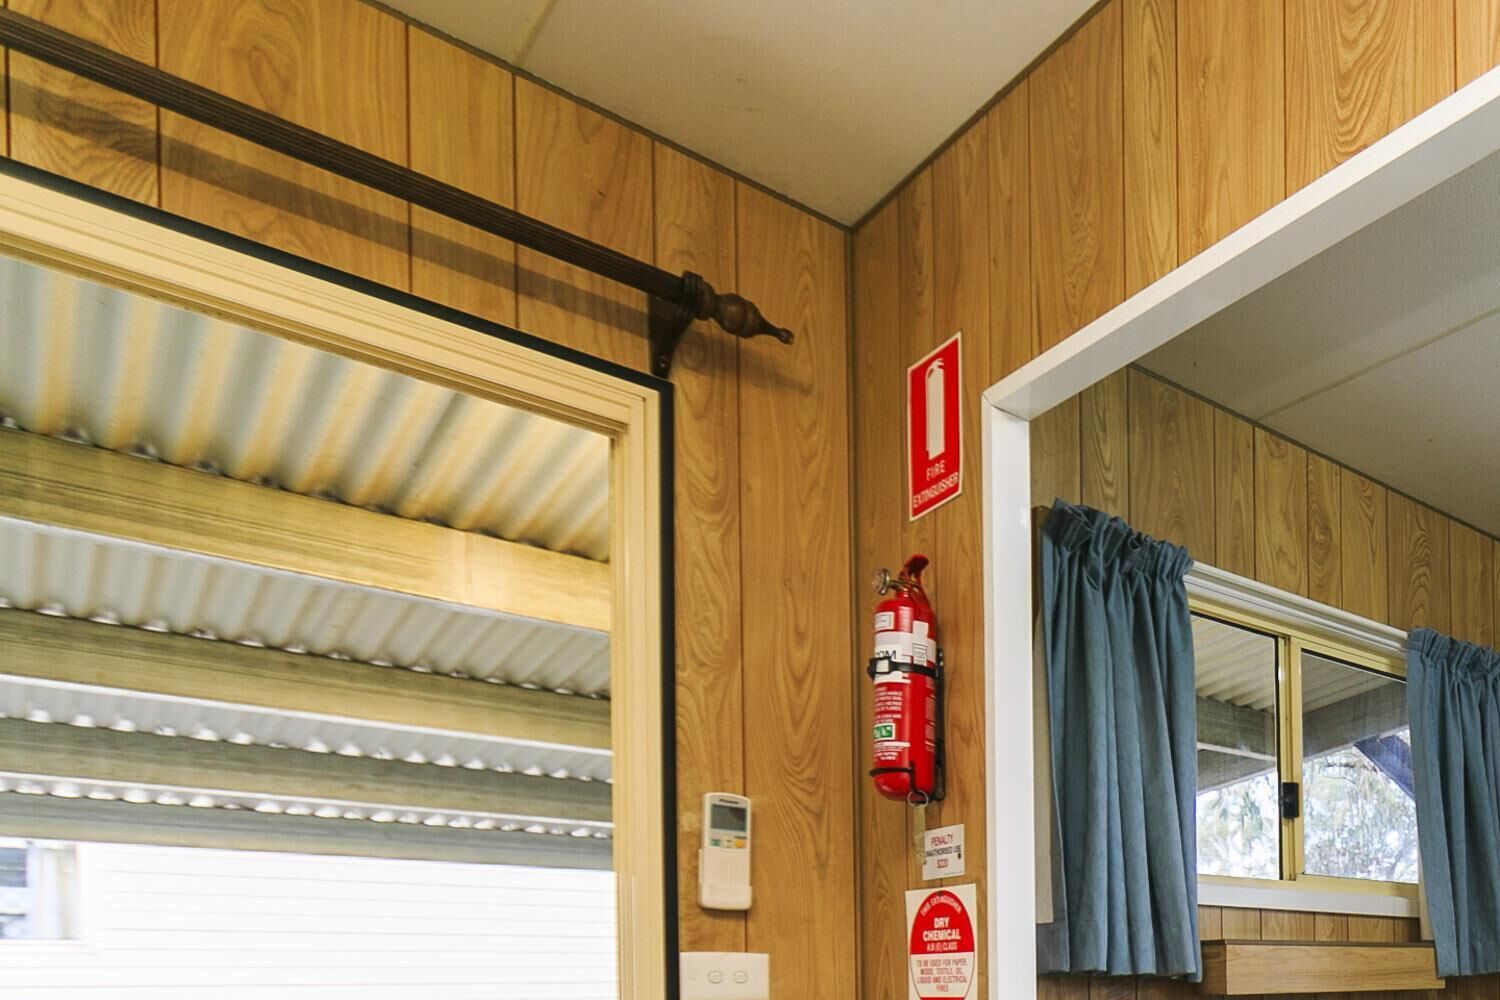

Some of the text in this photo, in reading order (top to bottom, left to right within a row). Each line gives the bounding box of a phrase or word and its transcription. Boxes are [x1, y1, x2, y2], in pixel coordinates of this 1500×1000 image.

[926, 459, 945, 481] FIRE
[913, 471, 959, 508] EXTINGUISHER
[931, 833, 953, 846] PENALTY
[934, 917, 950, 928] DRY
[922, 928, 962, 942] CHEMICAL
